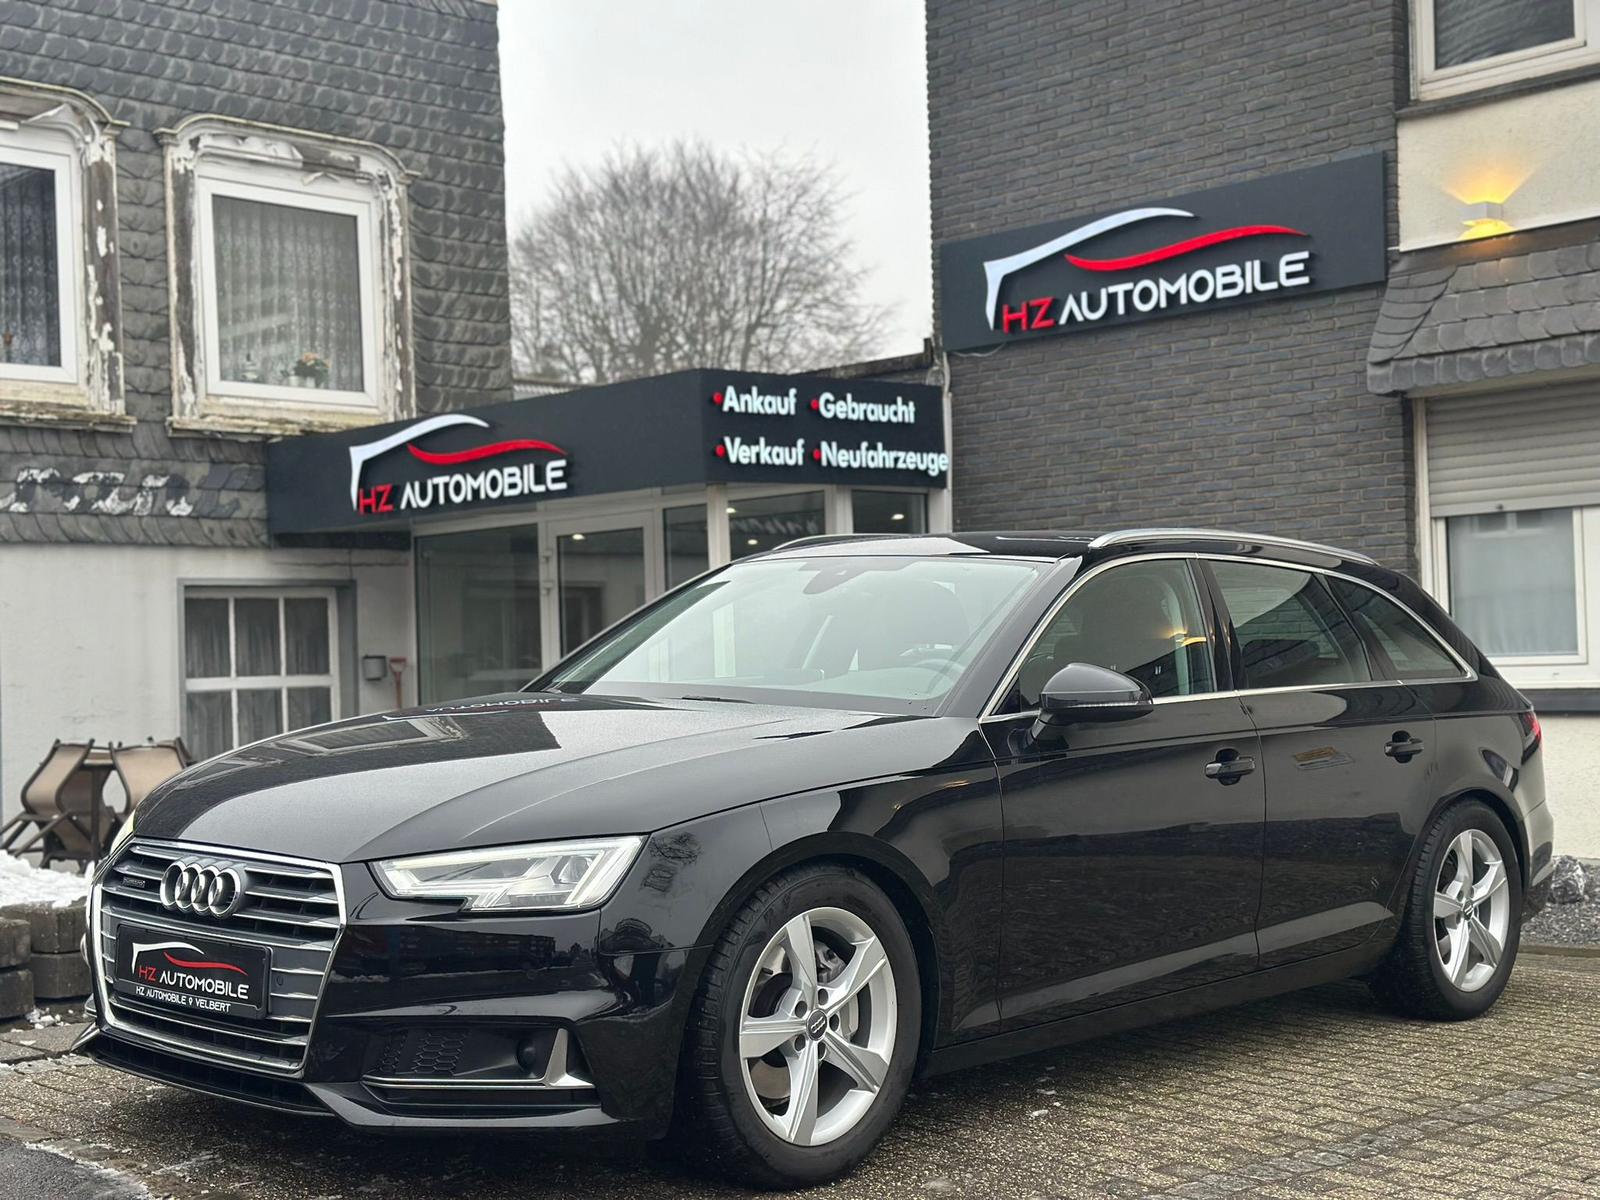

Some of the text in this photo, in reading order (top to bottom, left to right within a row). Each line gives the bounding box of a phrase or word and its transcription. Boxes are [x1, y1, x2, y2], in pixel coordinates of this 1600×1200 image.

[1002, 251, 1310, 334] HZ AUTOMOBILE
[722, 385, 915, 423] Ankauf Gebraucht
[723, 435, 949, 477] Verkauf Neufahrzeuge
[359, 459, 568, 515] HZ AUTOMOBILE
[135, 986, 232, 1013] HZ AUTOMOBILE VELBERT
[138, 965, 249, 999] HZ AUTOMOBILE
